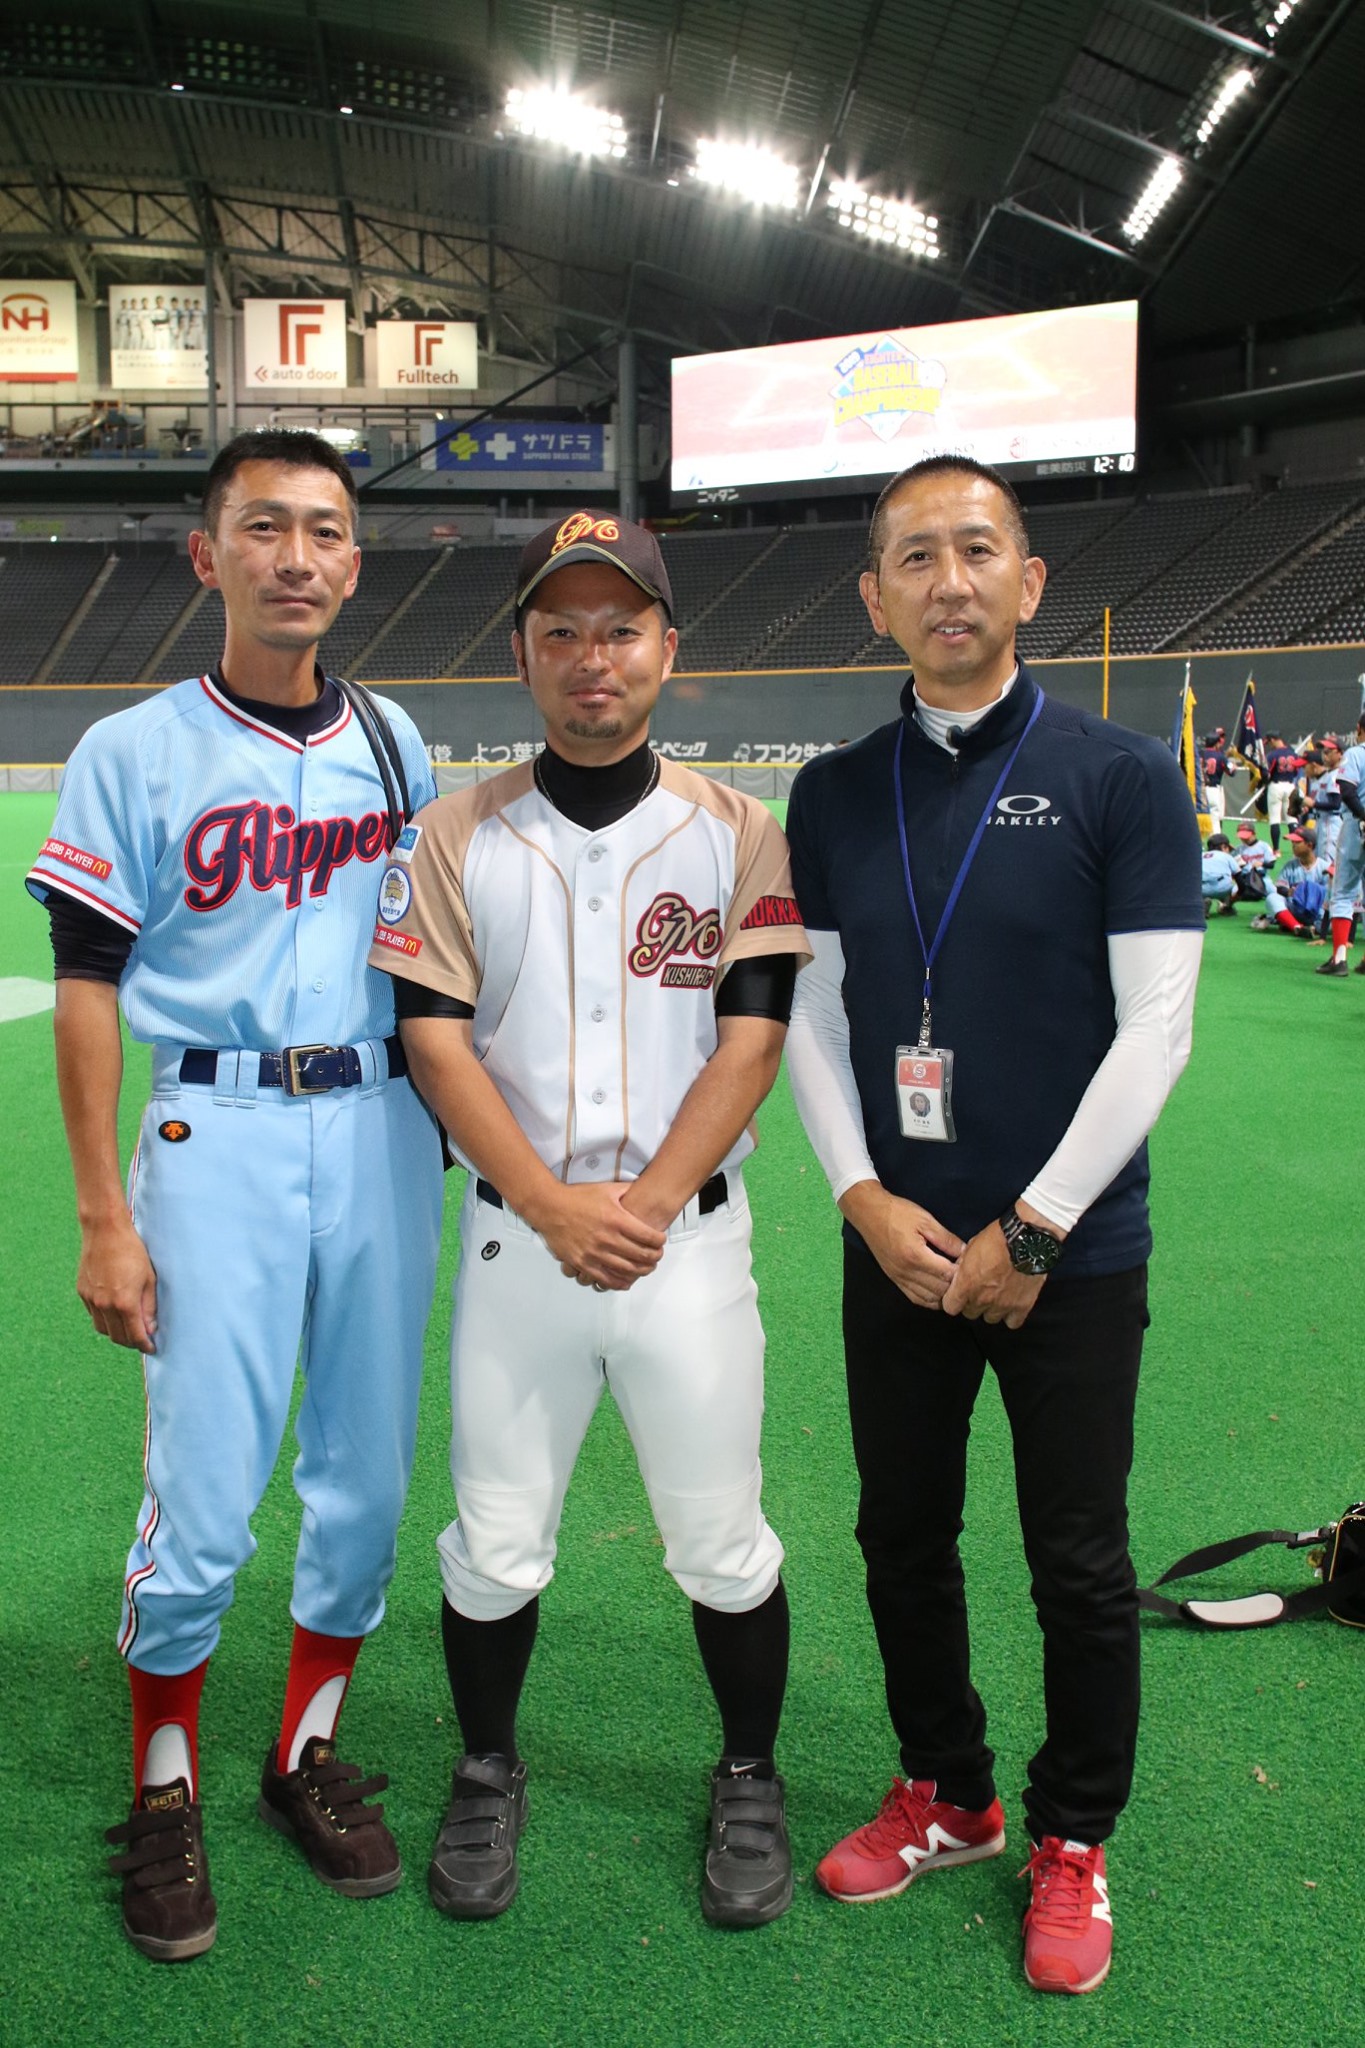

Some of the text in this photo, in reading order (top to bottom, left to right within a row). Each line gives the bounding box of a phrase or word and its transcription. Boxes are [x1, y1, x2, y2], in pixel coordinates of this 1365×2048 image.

[272, 367, 338, 381] auto door
[397, 369, 459, 384] Fulltech
[64, 848, 94, 869] PLAYER
[386, 932, 405, 948] PLAYER
